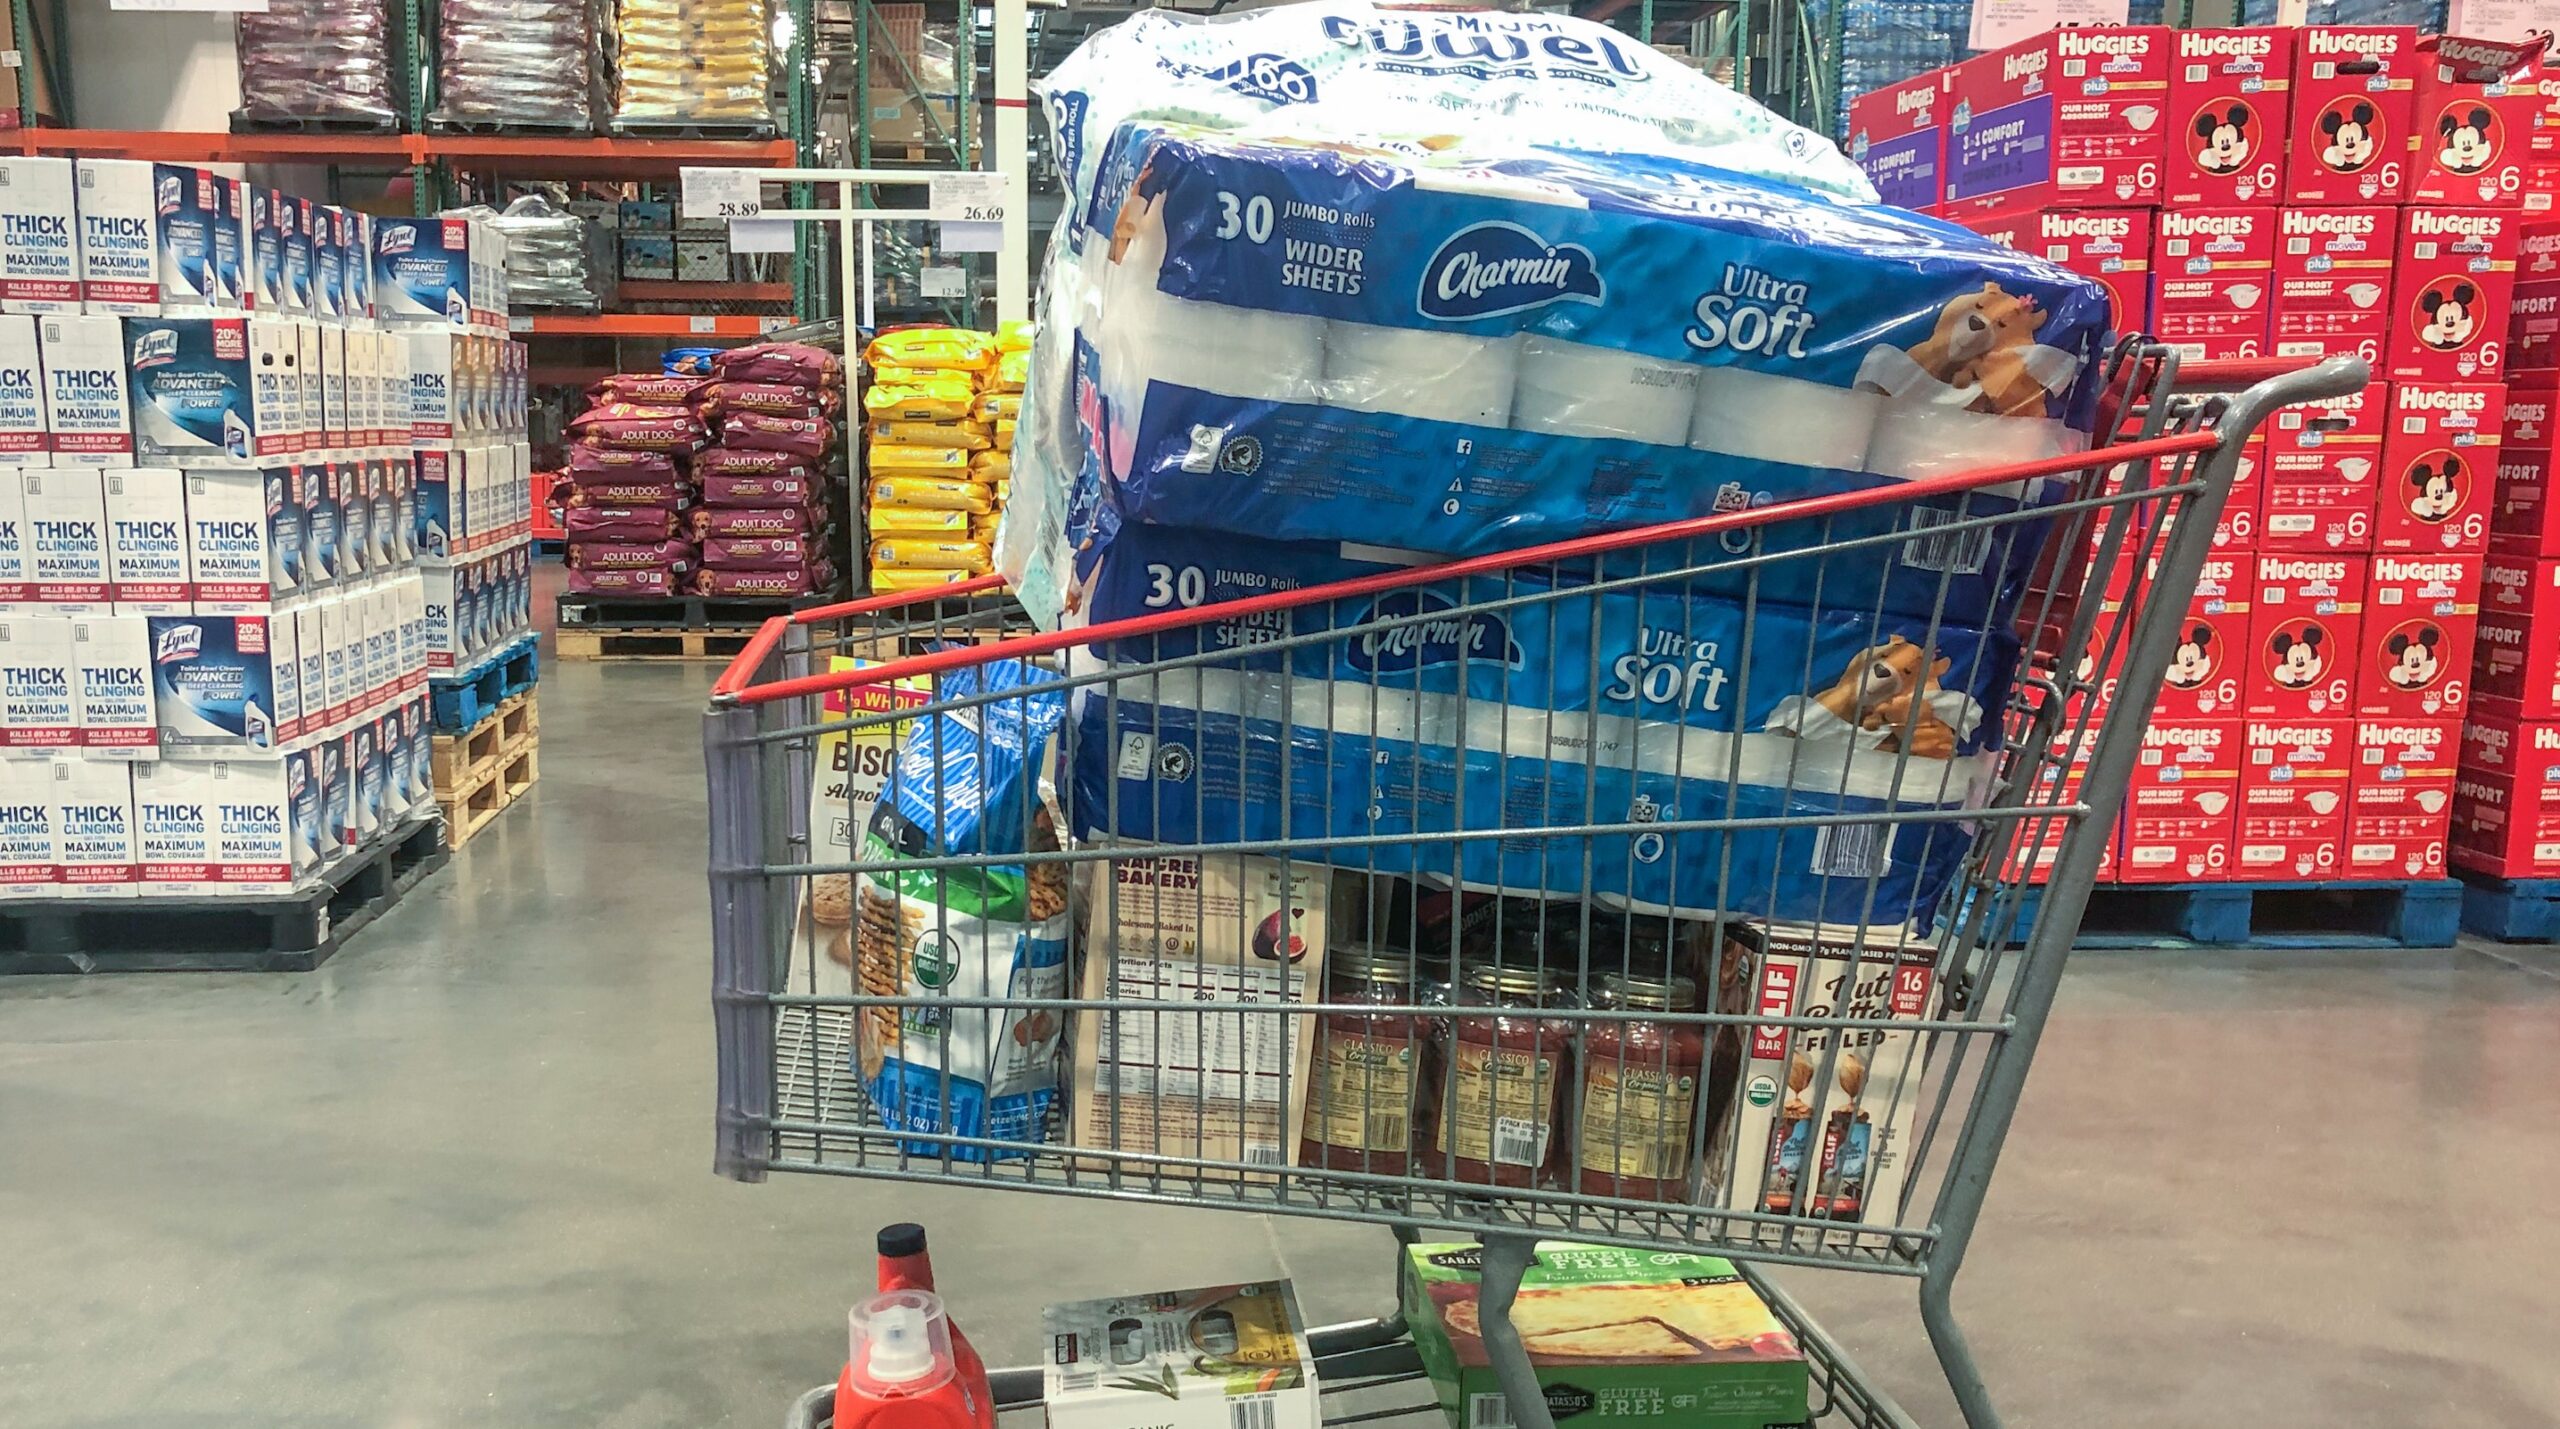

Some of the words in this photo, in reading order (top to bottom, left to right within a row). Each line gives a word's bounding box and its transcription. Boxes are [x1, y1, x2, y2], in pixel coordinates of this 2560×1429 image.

[2059, 32, 2149, 57] HUGGIES
[2181, 33, 2271, 57] HUGGIES
[2309, 30, 2398, 54] HUGGIES
[2004, 48, 2048, 81] HUGGIES
[2102, 62, 2141, 72] movers
[2224, 62, 2263, 72] movers
[1897, 86, 1935, 115] HUGGIES
[2061, 104, 2081, 113] OUR
[2083, 104, 2110, 112] MOST
[1982, 120, 2025, 145] COMFORT
[2116, 175, 2135, 184] 120
[2137, 163, 2156, 188] 6
[2237, 176, 2255, 185] 120
[2257, 164, 2276, 189] 6
[2361, 174, 2378, 184] 120
[2381, 162, 2399, 188] 6
[2479, 177, 2498, 186] 120
[2500, 166, 2520, 191] 6
[718, 202, 759, 217] 28.89
[964, 206, 1004, 220] 26.69
[1216, 191, 1274, 244] 30
[1283, 200, 1338, 225] JUMBO
[1343, 208, 1375, 228] Rolls
[2, 214, 67, 234] THICK
[86, 216, 147, 236] THICK
[444, 226, 464, 235] 20%
[2042, 214, 2129, 238] HUGGIES
[2163, 214, 2253, 237] HUGGIES
[2283, 212, 2376, 234] HUGGIES
[2411, 212, 2502, 235] HUGGIES
[5, 234, 68, 247] CLINGING
[88, 236, 149, 249] CLINGING
[6, 254, 69, 266] MAXIMUM
[89, 256, 149, 268] MAXIMUM
[1286, 237, 1364, 272] WIDER
[394, 263, 447, 272] ADVANCED
[1438, 246, 1572, 301] Charmin
[1282, 264, 1362, 297] SHEETS
[1723, 265, 1808, 305] Ultra
[941, 288, 965, 296] 12.99
[216, 329, 242, 339] 20%
[1686, 294, 1816, 359] Soft
[137, 334, 176, 352] Lysol
[216, 340, 243, 348] MORE
[2358, 340, 2377, 364] 6
[2460, 352, 2477, 361] 120
[2480, 342, 2499, 366] 6
[53, 371, 117, 387] THICK
[150, 379, 226, 390] ADVANCED
[56, 389, 118, 400] CLINGING
[740, 392, 768, 402] ADULT
[770, 394, 792, 403] DOG
[2400, 387, 2486, 410] HUGGIES
[57, 408, 120, 419] MAXIMUM
[621, 431, 649, 440] ADULT
[651, 430, 674, 440] DOG
[140, 441, 149, 453] 4
[723, 457, 750, 466] ADULT
[752, 458, 775, 467] DOG
[34, 522, 97, 539] THICK
[115, 522, 177, 538] THICK
[196, 522, 258, 539] THICK
[731, 520, 759, 529] ADULT
[761, 520, 784, 529] DOG
[2233, 512, 2250, 536] 6
[2328, 524, 2344, 532] 120
[2348, 512, 2366, 537] 6
[2444, 524, 2460, 533] 120
[2464, 513, 2483, 538] 6
[36, 540, 98, 551] CLINGING
[118, 540, 179, 551] CLINGING
[199, 540, 259, 551] CLINGING
[38, 559, 99, 569] MAXIMUM
[120, 559, 180, 569] MAXIMUM
[200, 559, 260, 569] MAXIMUM
[602, 552, 629, 561] ADULT
[631, 552, 654, 561] DOG
[2260, 558, 2346, 580] HUGGIES
[2375, 559, 2463, 581] HUGGIES
[1144, 564, 1206, 608] 30
[1213, 569, 1267, 588] JUMBO
[238, 624, 263, 634] 20%
[161, 627, 198, 651] Lysol
[3, 668, 66, 684] THICK
[82, 668, 144, 684] THICK
[175, 673, 243, 681] ADVANCED
[1606, 655, 1728, 711] Soft
[203, 691, 243, 700] POWER
[2218, 679, 2237, 703] 6
[2330, 679, 2347, 703] 6
[2444, 681, 2462, 704] 6
[164, 731, 173, 743] 4
[2249, 724, 2333, 745] HUGGIES
[2359, 724, 2442, 745] HUGGIES
[61, 806, 123, 821] THICK
[142, 805, 203, 820] THICK
[219, 805, 280, 821] THICK
[2207, 844, 2225, 867] 6
[2317, 843, 2335, 866] 6
[2425, 842, 2443, 865] 6
[1769, 942, 1811, 952] NON-GMO
[1820, 947, 1829, 956] 7g
[1902, 971, 1923, 992] 16
[1760, 970, 1790, 1038] CLIF
[1897, 993, 1922, 1002] ENERGY
[1900, 1002, 1917, 1010] BARS
[1758, 1039, 1781, 1051] BAR
[1554, 1259, 1641, 1270] FREE
[1700, 1276, 1736, 1285] PACK
[1599, 1387, 1661, 1400] GLUTEN
[1600, 1400, 1666, 1416] FREE
